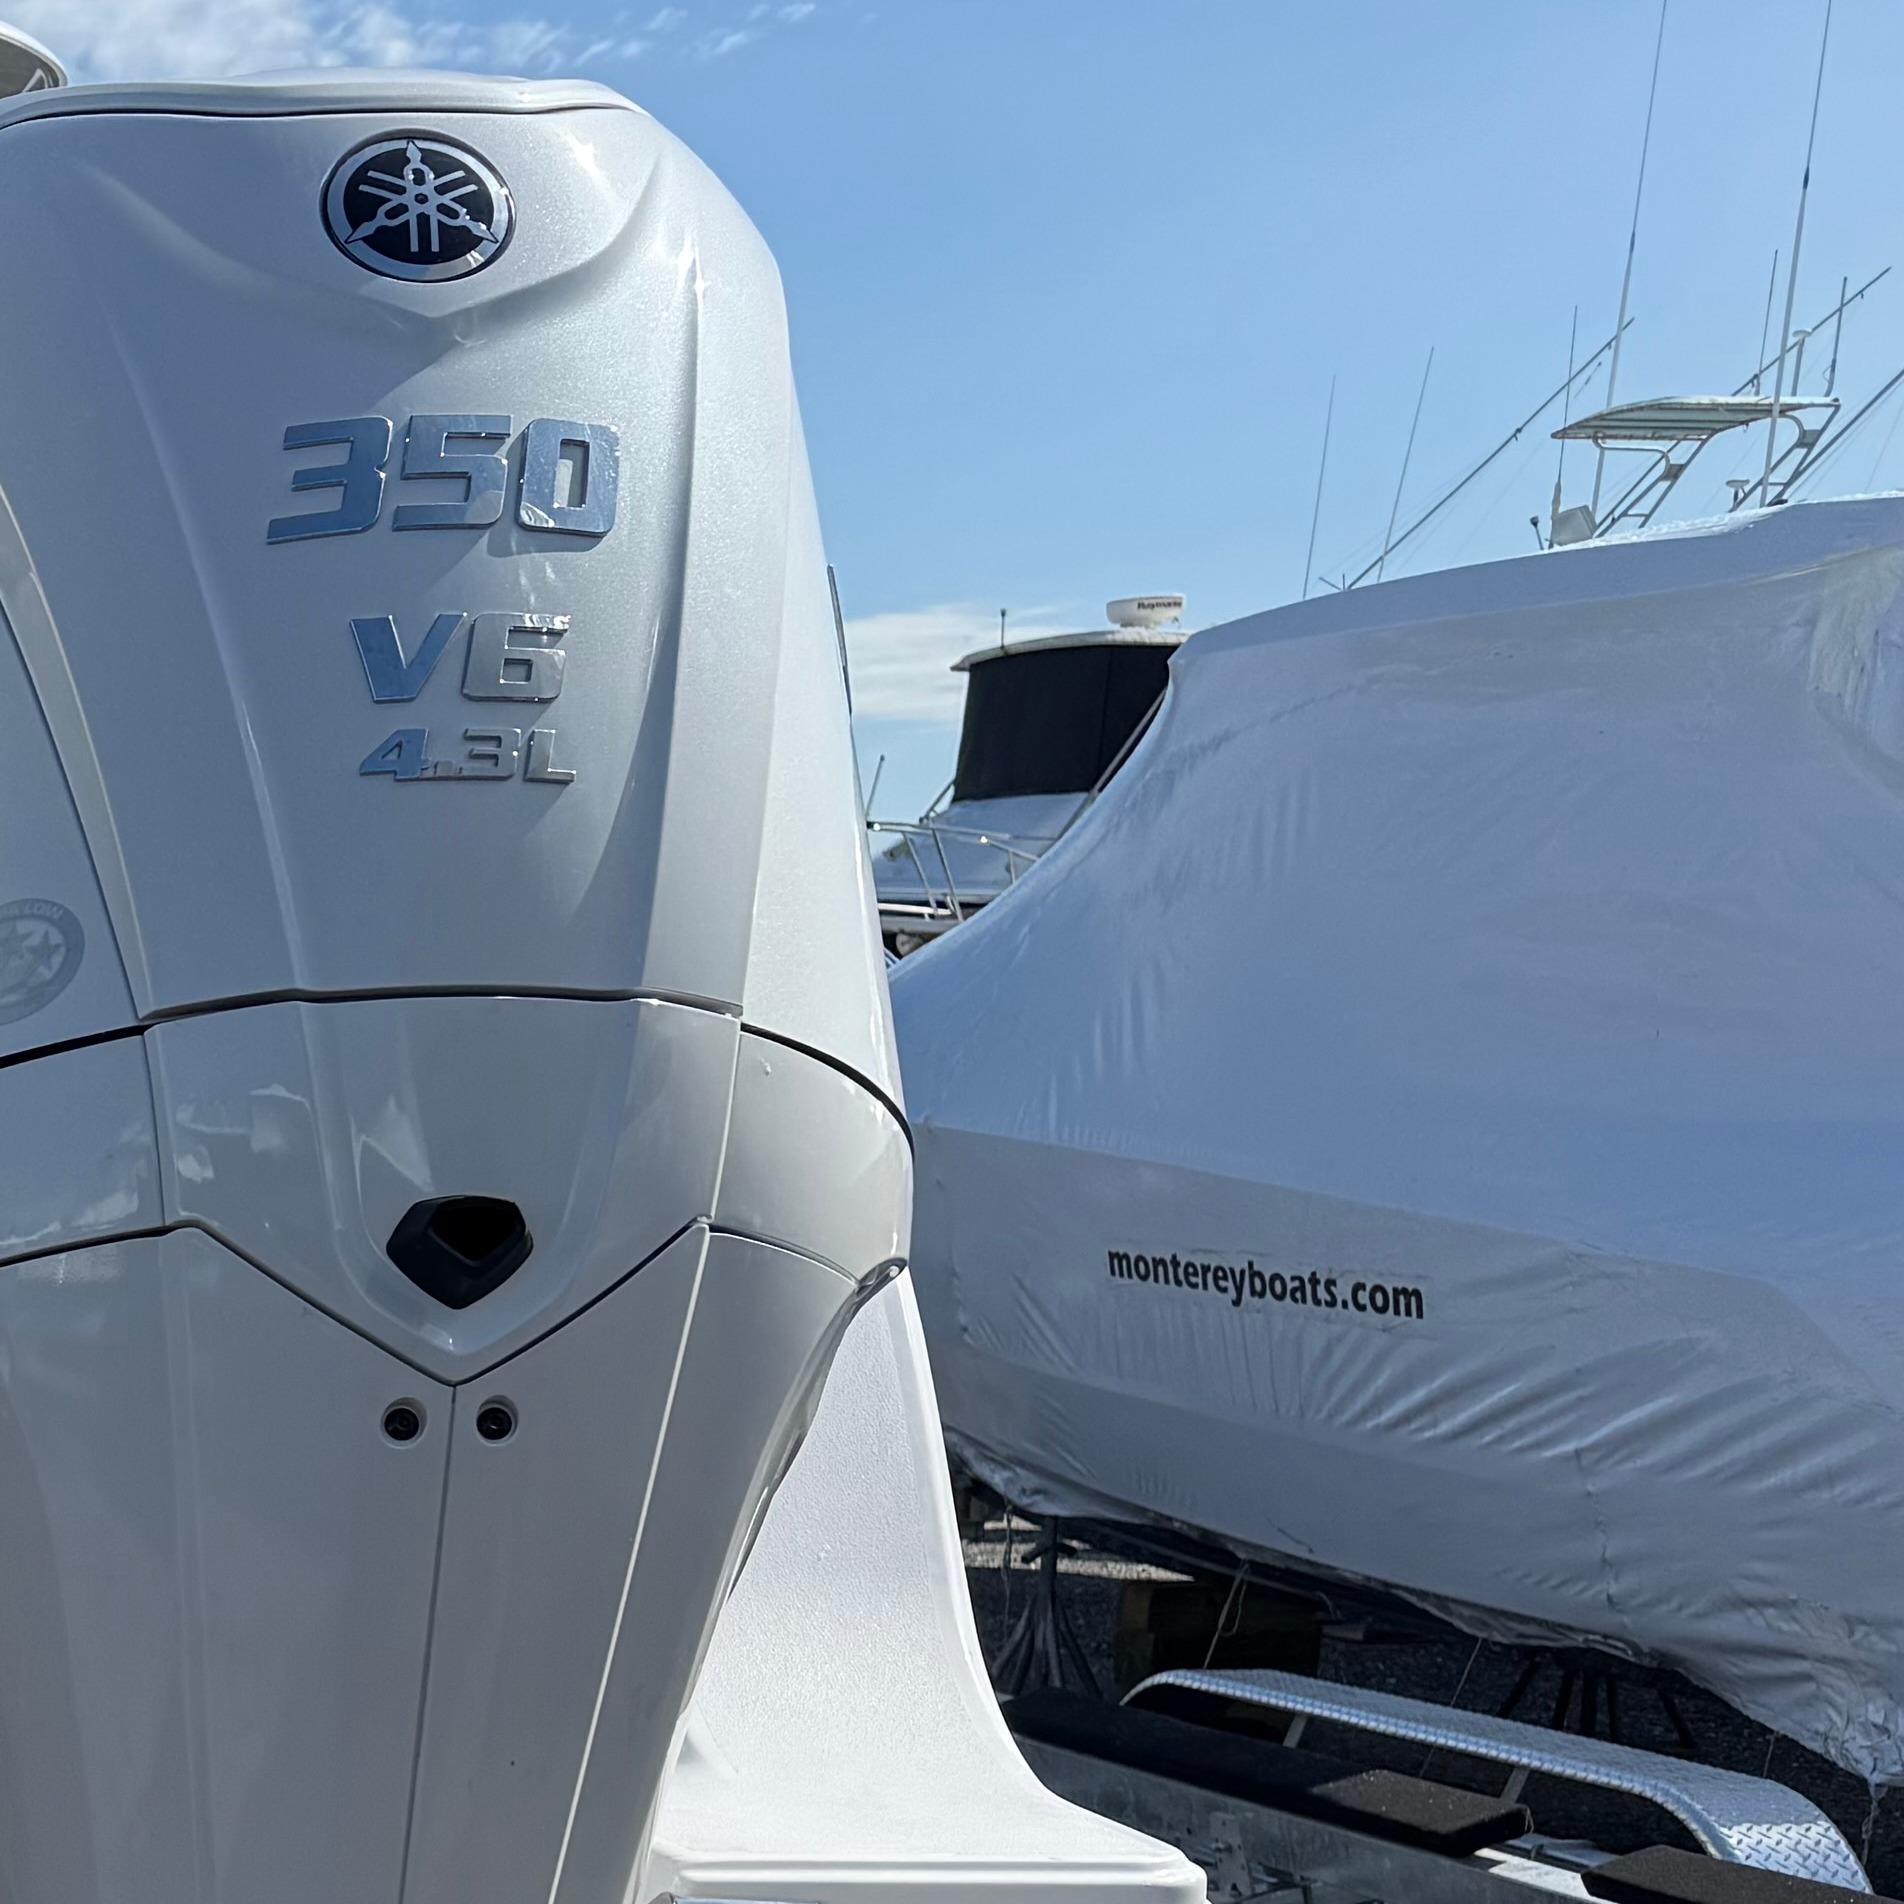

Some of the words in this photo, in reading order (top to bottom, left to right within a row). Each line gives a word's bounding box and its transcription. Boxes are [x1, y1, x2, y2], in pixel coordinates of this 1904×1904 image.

[266, 412, 620, 544] 350
[349, 612, 571, 703] V6
[1107, 1249, 1425, 1320] montereyboats.com
